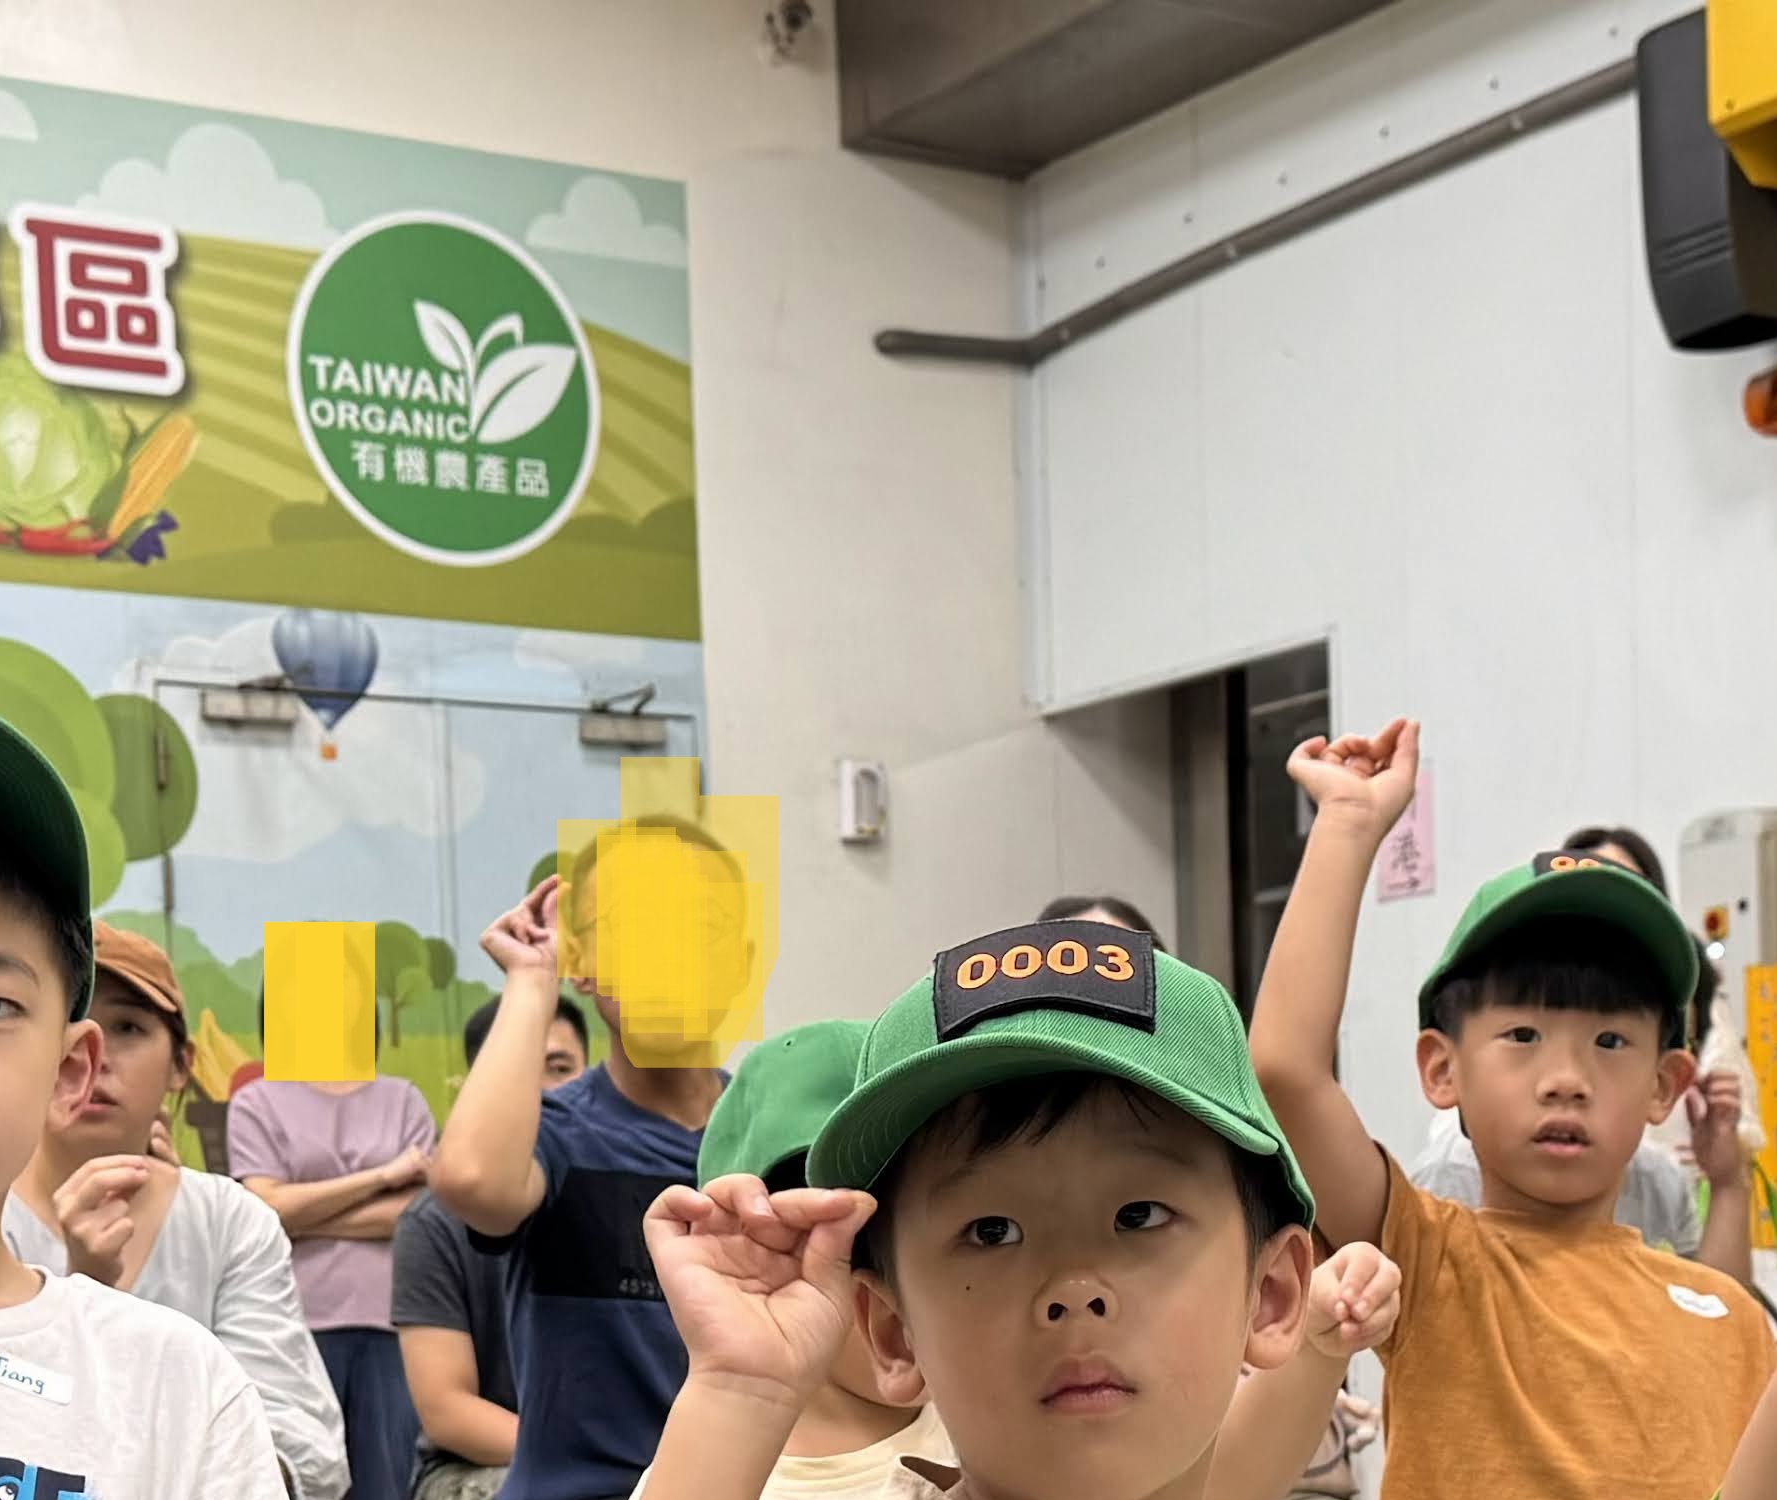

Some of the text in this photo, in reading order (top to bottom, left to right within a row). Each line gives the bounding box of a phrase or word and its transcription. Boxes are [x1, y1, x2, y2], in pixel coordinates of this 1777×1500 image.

[307, 355, 468, 407] TAIWAN
[308, 398, 471, 443] ORGANIC
[350, 440, 550, 498] 有機農產品
[955, 940, 1136, 990] 0003
